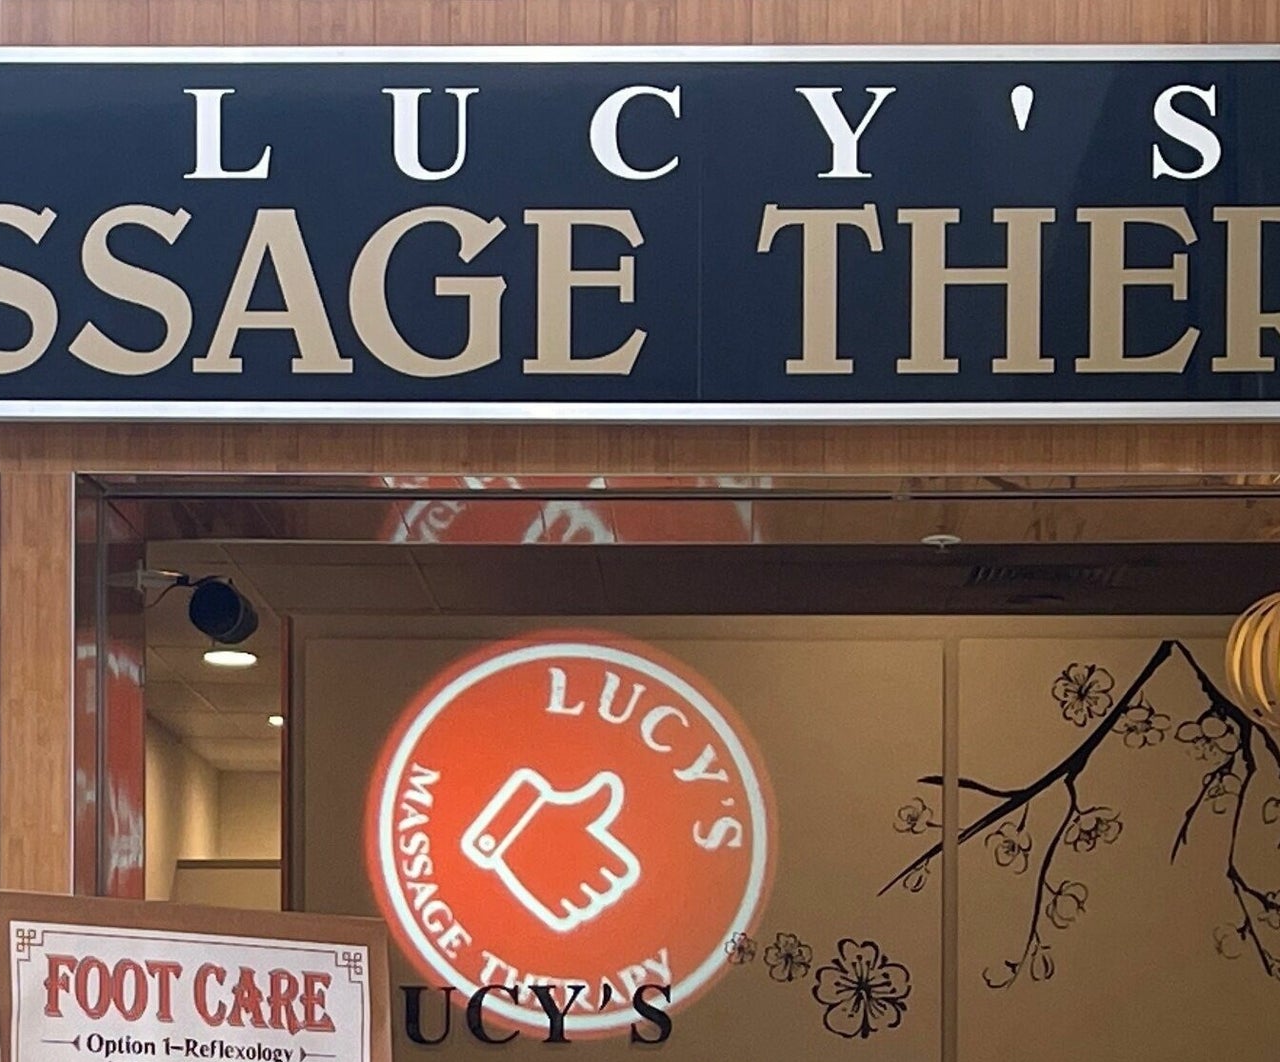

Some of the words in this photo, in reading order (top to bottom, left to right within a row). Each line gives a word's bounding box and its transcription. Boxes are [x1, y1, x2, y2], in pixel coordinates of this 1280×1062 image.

[183, 82, 1222, 181] LUCY'S
[545, 667, 744, 850] LUCY'S
[399, 762, 472, 959] MASSAGE
[480, 948, 672, 1011] THERAPY
[44, 953, 182, 1024] FOOT
[193, 961, 336, 1036] CARE
[399, 984, 673, 1044] UCY'S
[86, 1033, 156, 1058] Option
